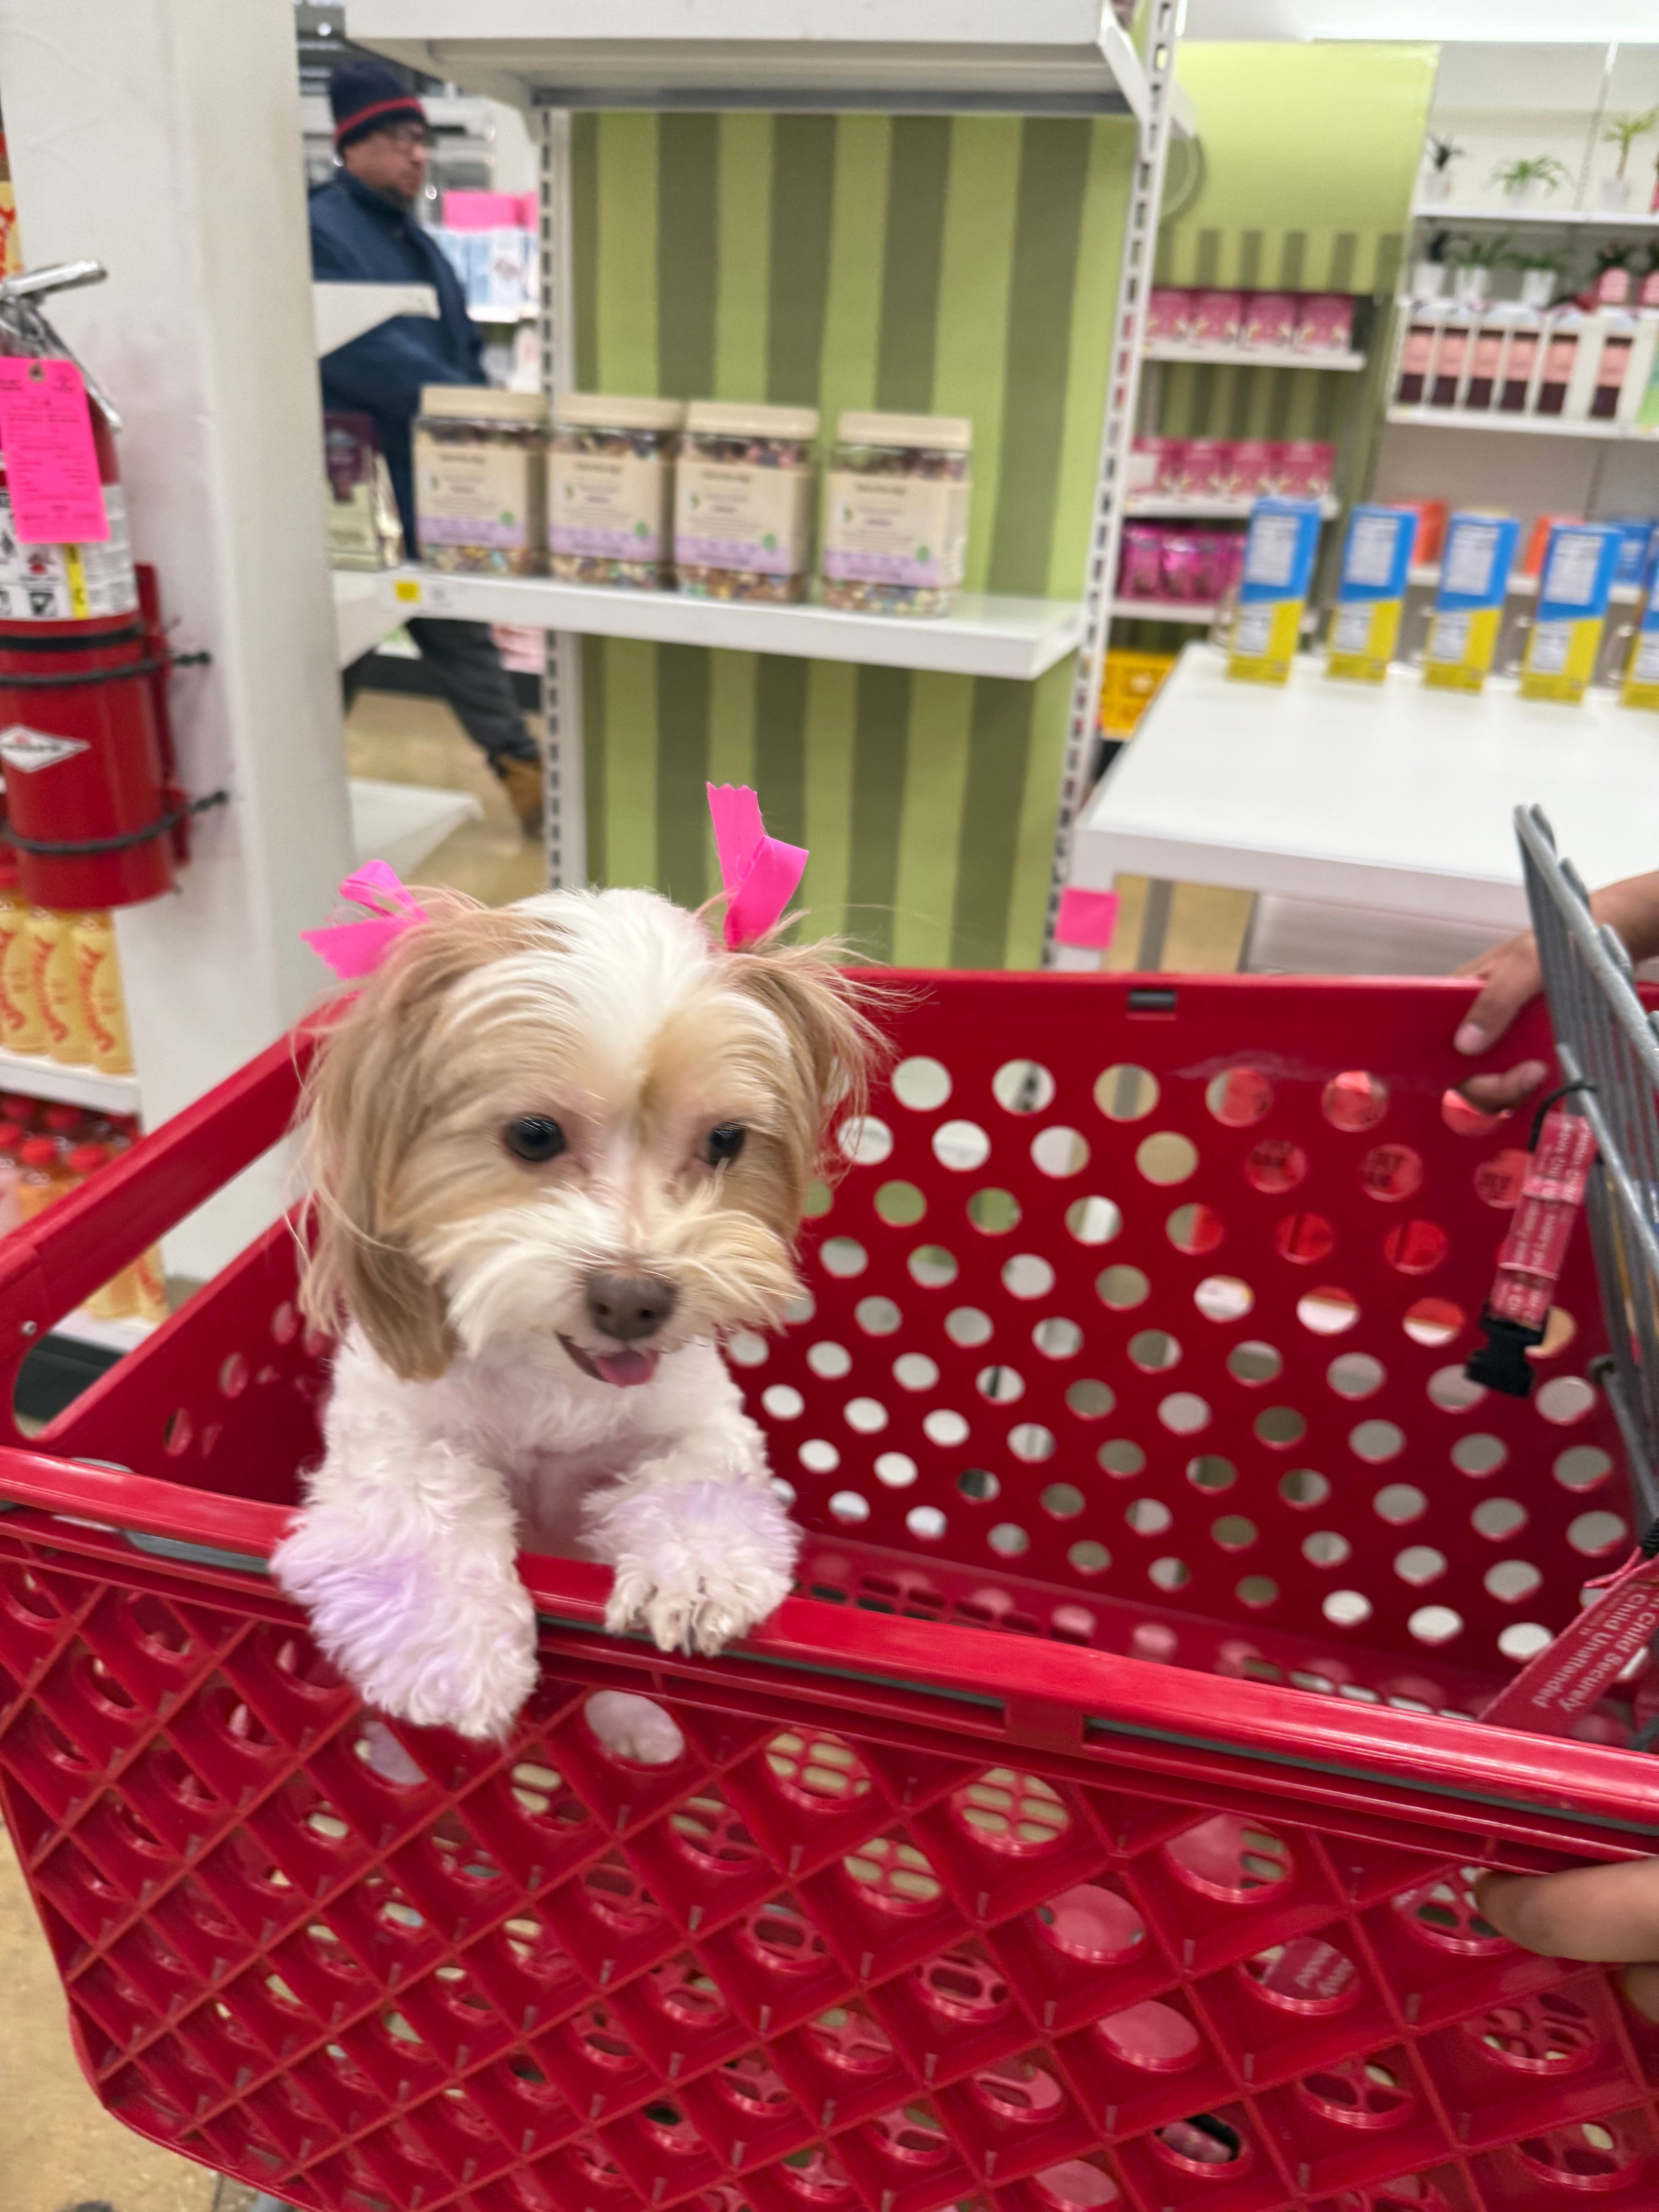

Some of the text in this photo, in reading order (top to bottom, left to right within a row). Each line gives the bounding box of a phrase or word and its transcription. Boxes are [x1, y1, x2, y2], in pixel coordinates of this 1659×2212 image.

[1603, 1594, 1647, 1631] Child
[1614, 1612, 1656, 1652] Child
[1532, 1632, 1614, 1708] Unattended
[1558, 1652, 1624, 1712] Securely
